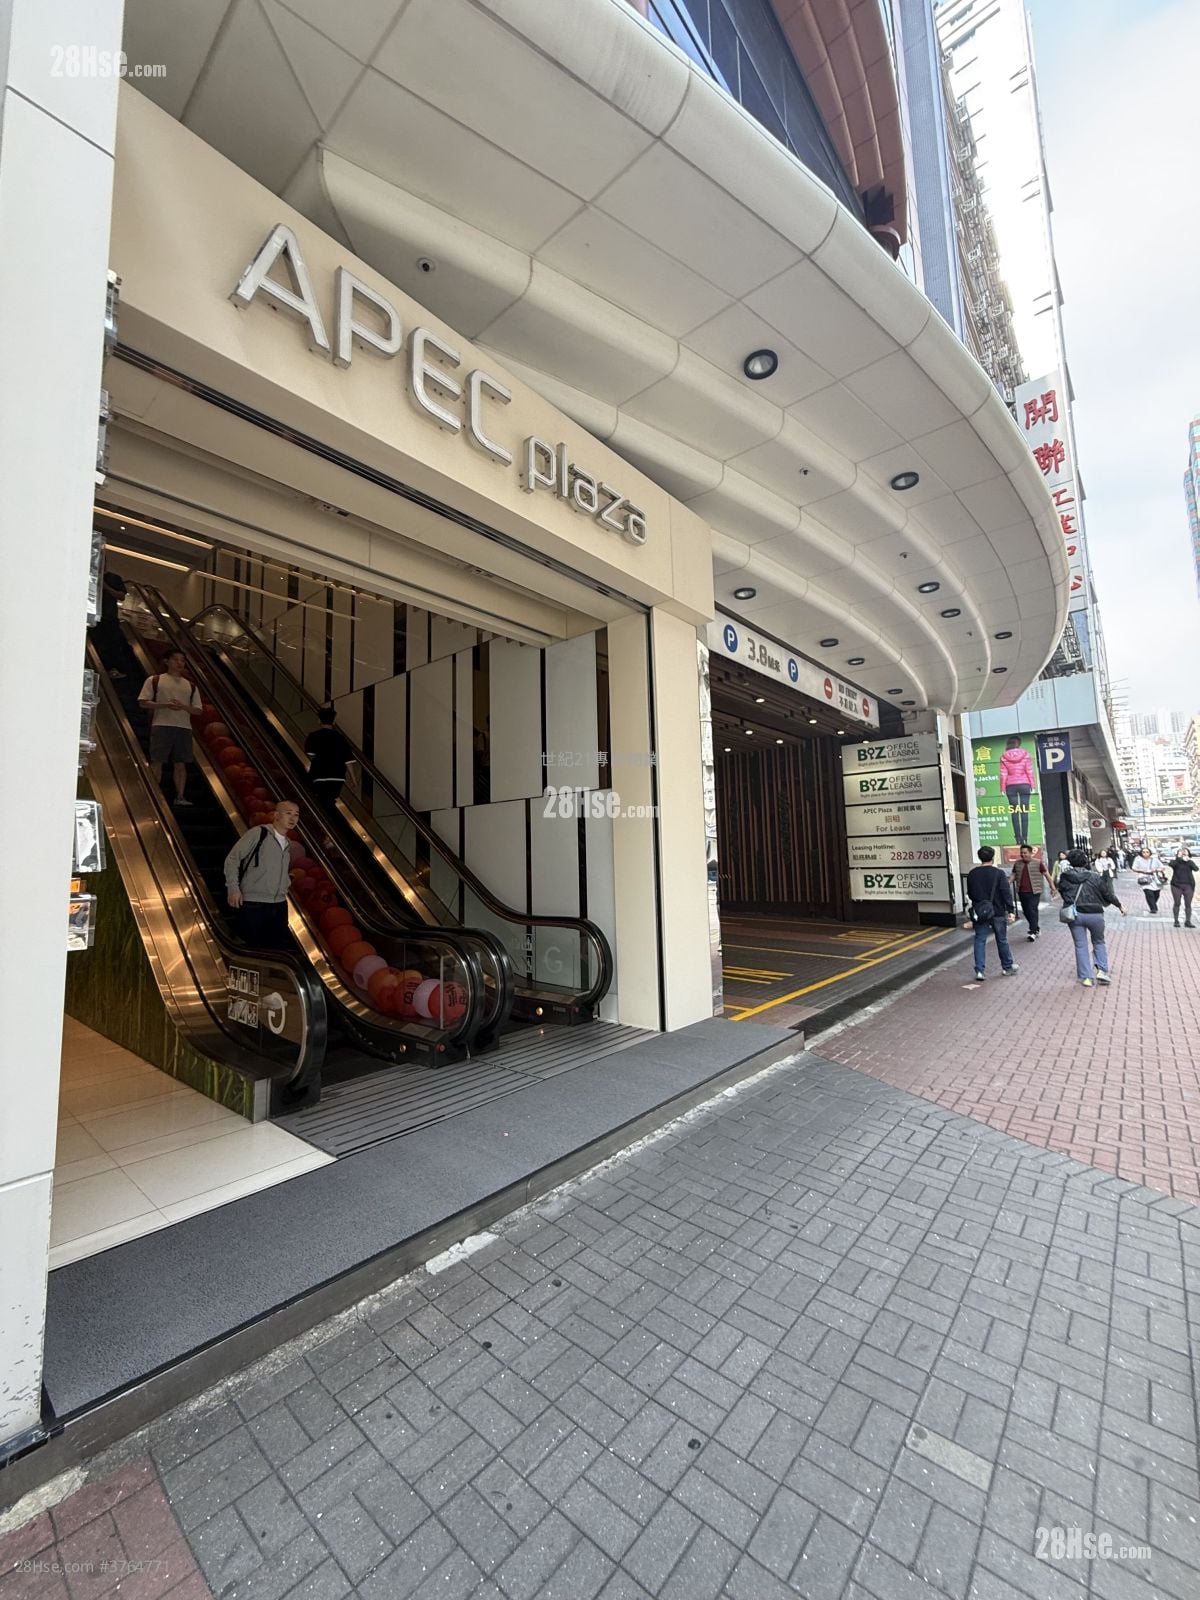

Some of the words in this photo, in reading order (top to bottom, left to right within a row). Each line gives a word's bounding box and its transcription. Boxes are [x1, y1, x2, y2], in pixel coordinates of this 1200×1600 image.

[228, 223, 512, 467] APEC
[522, 434, 648, 546] plaza
[886, 741, 919, 752] OFFICE
[887, 749, 920, 759] LEASING
[1045, 748, 1065, 770] P
[888, 773, 921, 784] OFFICE
[890, 781, 922, 791] LEASING
[1007, 803, 1037, 814] SALE
[890, 852, 914, 861] 2828
[916, 850, 942, 860] 7899
[898, 881, 934, 889] LEASING
